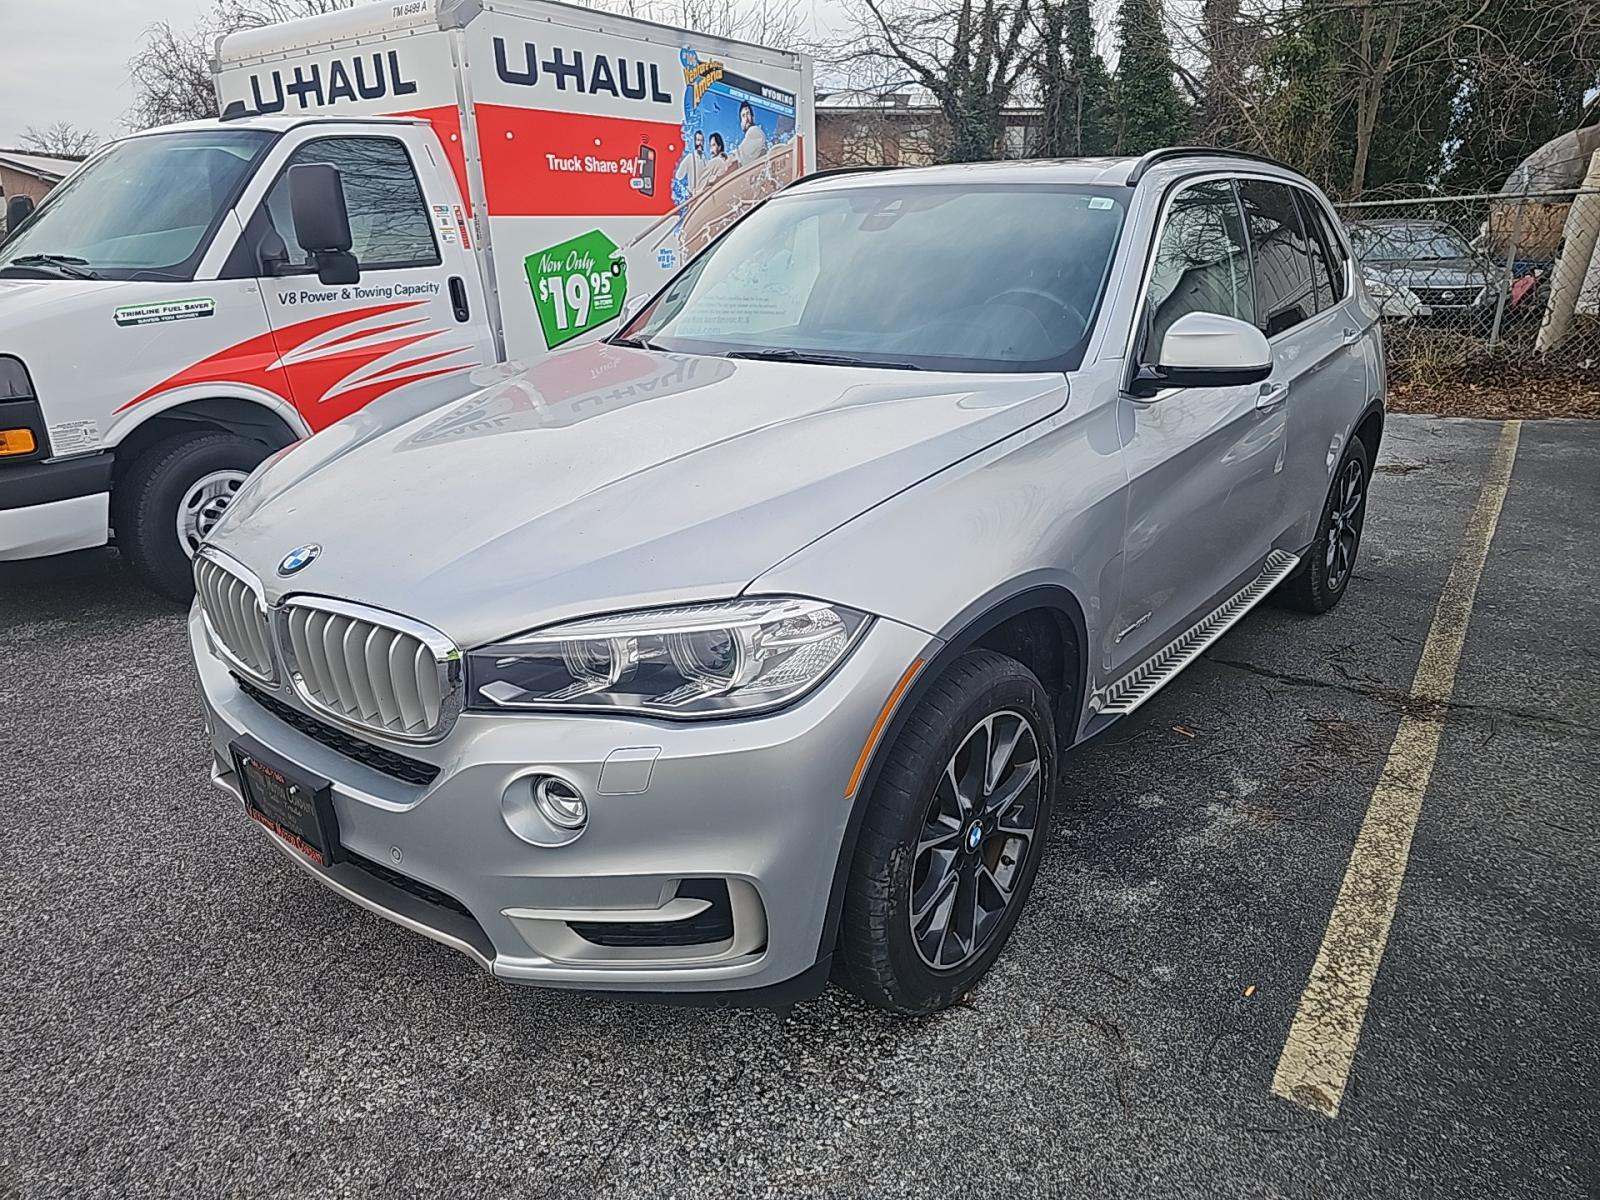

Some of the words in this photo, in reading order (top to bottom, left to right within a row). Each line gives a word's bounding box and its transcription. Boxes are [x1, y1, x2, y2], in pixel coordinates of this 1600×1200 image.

[250, 50, 417, 114] U-HAUL
[492, 36, 672, 104] U-HAUL
[761, 86, 794, 106] WYOMING
[545, 153, 582, 172] Truck
[584, 156, 618, 173] Share
[619, 156, 646, 176] 24/7
[537, 253, 563, 274] Now
[566, 250, 596, 277] Only
[278, 291, 297, 305] V8
[300, 290, 338, 303] Power
[341, 287, 351, 300] &
[353, 285, 392, 299] Towing
[394, 281, 440, 296] Capacity
